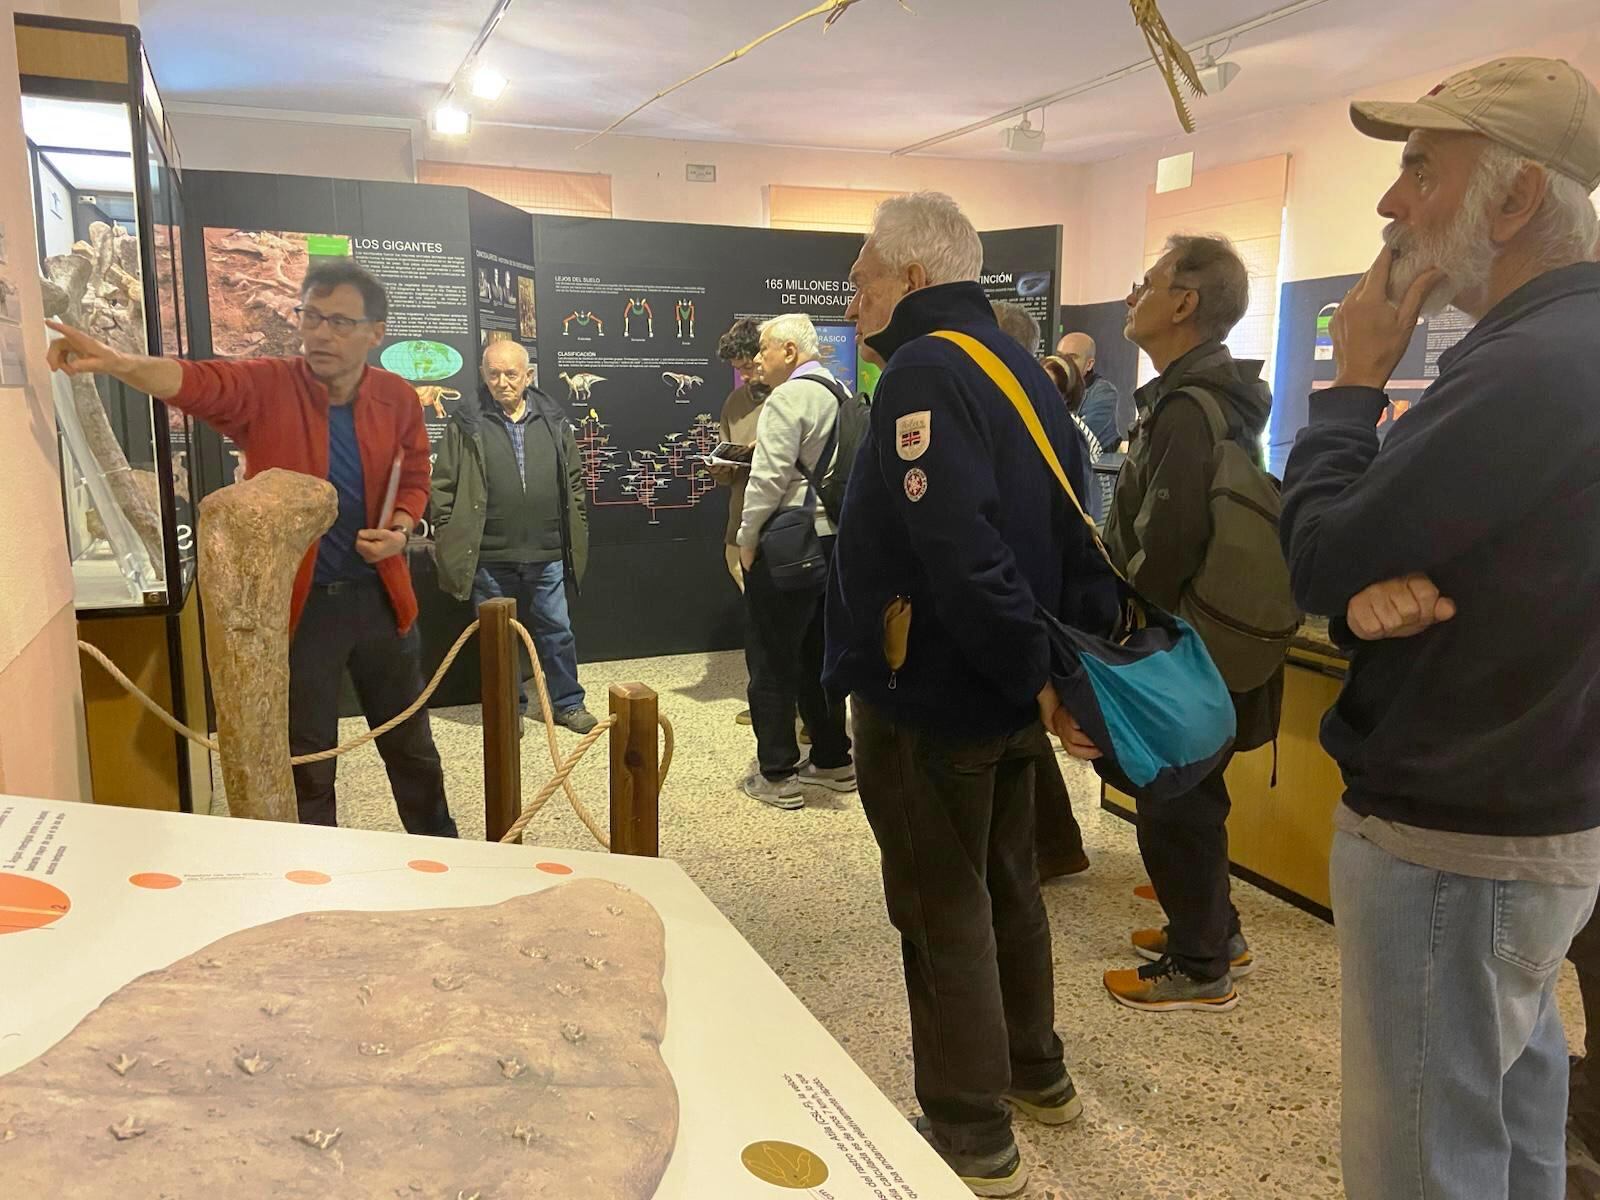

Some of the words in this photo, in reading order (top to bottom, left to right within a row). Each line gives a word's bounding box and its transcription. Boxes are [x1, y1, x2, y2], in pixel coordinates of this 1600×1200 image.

[354, 238, 379, 250] LOS
[382, 239, 443, 253] GIGANTES
[764, 279, 783, 290] 165
[785, 279, 840, 292] MILLONES
[781, 293, 797, 305] DE
[799, 294, 855, 306] DINOSAUR
[817, 335, 847, 343] RASICO
[828, 1097, 868, 1139] relativamente
[843, 1132, 855, 1142] de
[836, 1142, 849, 1152] de
[851, 1142, 863, 1151] es
[864, 1139, 894, 1171] andando
[845, 1152, 867, 1174] rastro
[859, 1151, 892, 1187] calculada
[860, 1174, 877, 1188] del
[890, 1171, 905, 1184] iba
[901, 1184, 918, 1199] que
